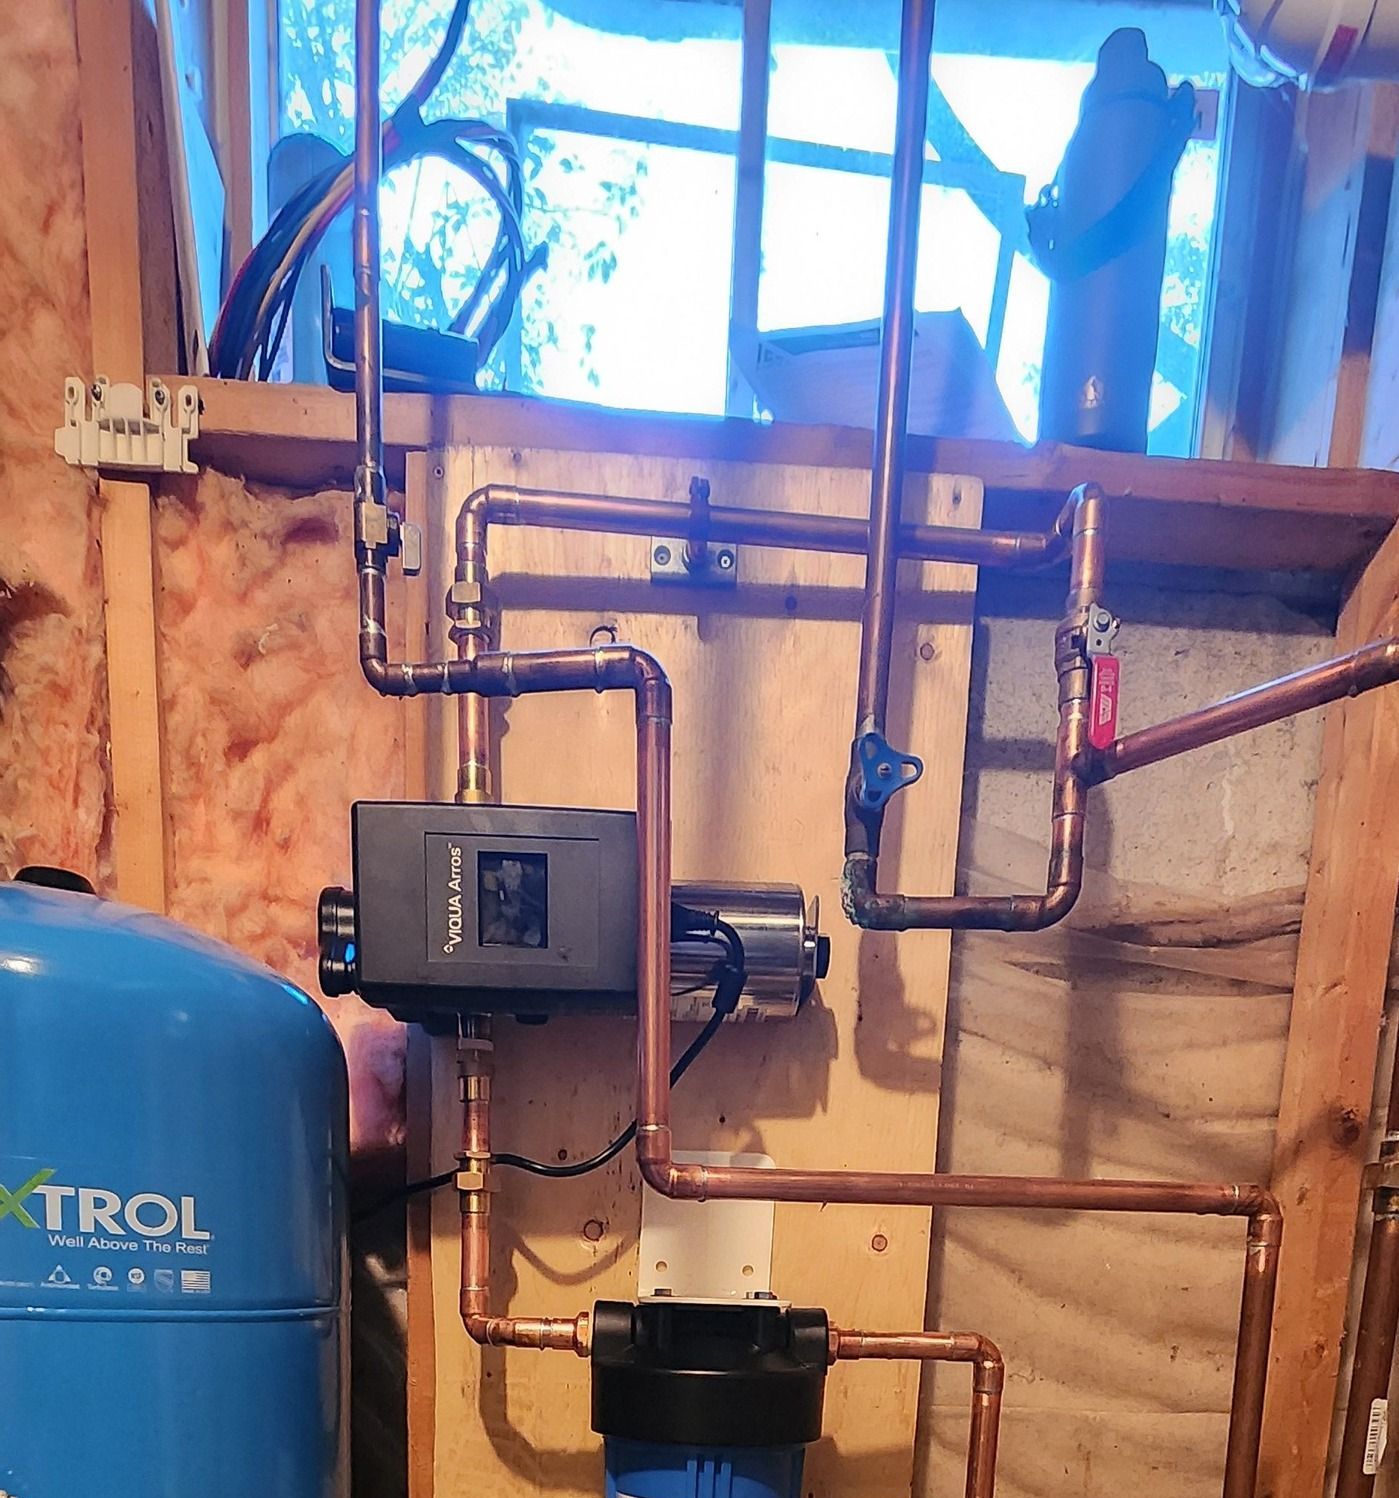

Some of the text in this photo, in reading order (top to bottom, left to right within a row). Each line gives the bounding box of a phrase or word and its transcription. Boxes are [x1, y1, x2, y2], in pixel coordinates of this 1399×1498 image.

[448, 895, 462, 946] VIQUA
[48, 1233, 84, 1248] Well
[88, 1236, 138, 1251] Above
[143, 1239, 171, 1253] The
